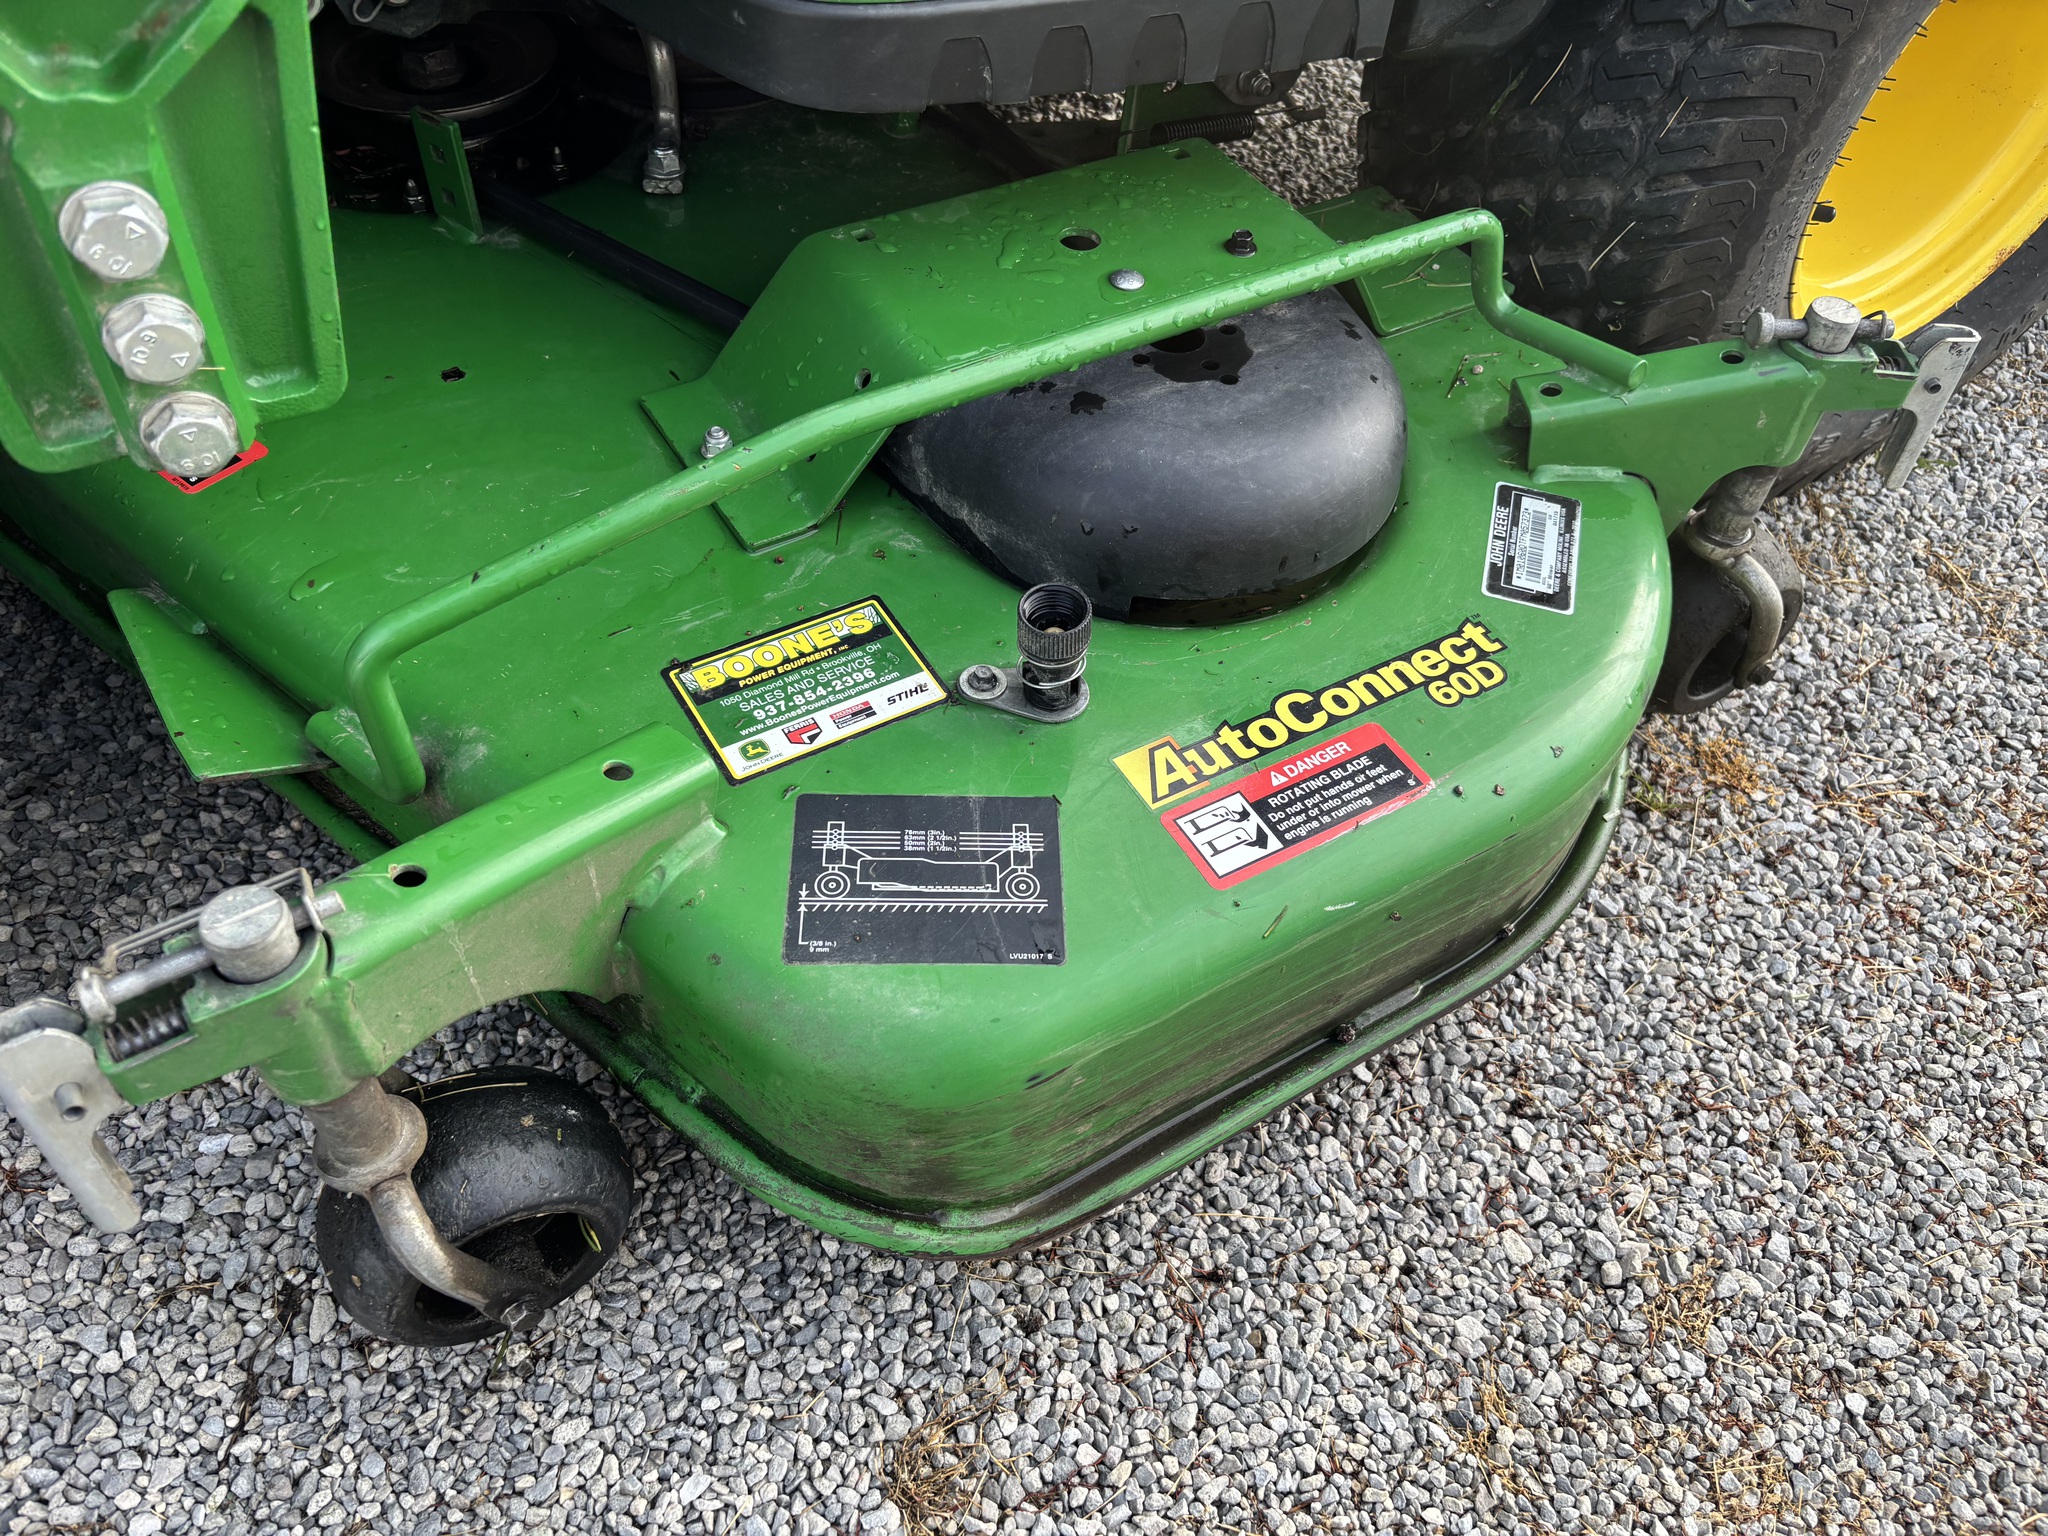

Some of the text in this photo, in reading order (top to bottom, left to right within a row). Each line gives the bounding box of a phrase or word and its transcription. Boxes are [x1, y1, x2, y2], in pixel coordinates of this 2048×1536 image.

[1490, 505, 1509, 567] JOHN DEERE
[1507, 525, 1517, 556] Serial Number
[692, 612, 874, 691] BOONE'S
[720, 642, 882, 707] 1050 Diamond Mill Rd Brookville, OH
[739, 669, 775, 688] POWER
[739, 655, 875, 712] SALES AND SERVICE
[753, 667, 876, 721] 937-854-2396
[887, 686, 929, 706] STIHL
[1427, 660, 1504, 705] 60D
[739, 671, 900, 736] www.BoonesPowerEquipment.com
[783, 718, 815, 734] FERRIS
[833, 703, 864, 718] HONDA
[1152, 621, 1503, 800] AutoConnect
[742, 752, 784, 772] JOHN DEERE
[1267, 755, 1373, 808] ROTATING BLADE
[1283, 741, 1352, 778] DANGER
[1267, 763, 1388, 823] Do not put hands or feet
[1276, 769, 1405, 831] under or into mower when
[1283, 796, 1373, 841] engine is running
[824, 940, 837, 948] in.)
